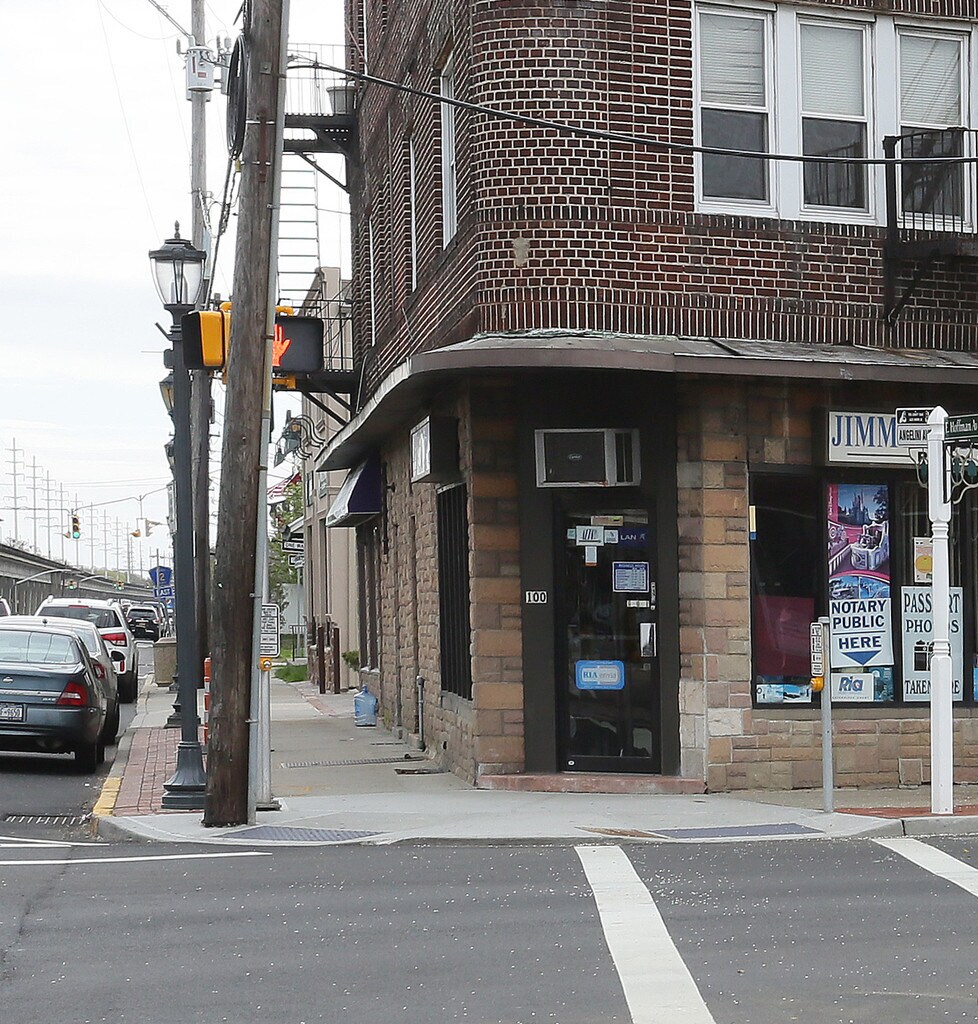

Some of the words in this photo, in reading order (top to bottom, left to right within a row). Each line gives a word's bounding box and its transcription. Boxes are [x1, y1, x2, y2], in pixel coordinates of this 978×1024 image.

[832, 416, 898, 448] JIMM
[950, 419, 971, 433] Hoffman
[159, 572, 166, 581] 2
[527, 592, 547, 603] 100
[831, 599, 887, 614] NOTARY
[832, 615, 885, 629] PUBLIC
[838, 636, 882, 650] HERE
[838, 676, 863, 692] Ria
